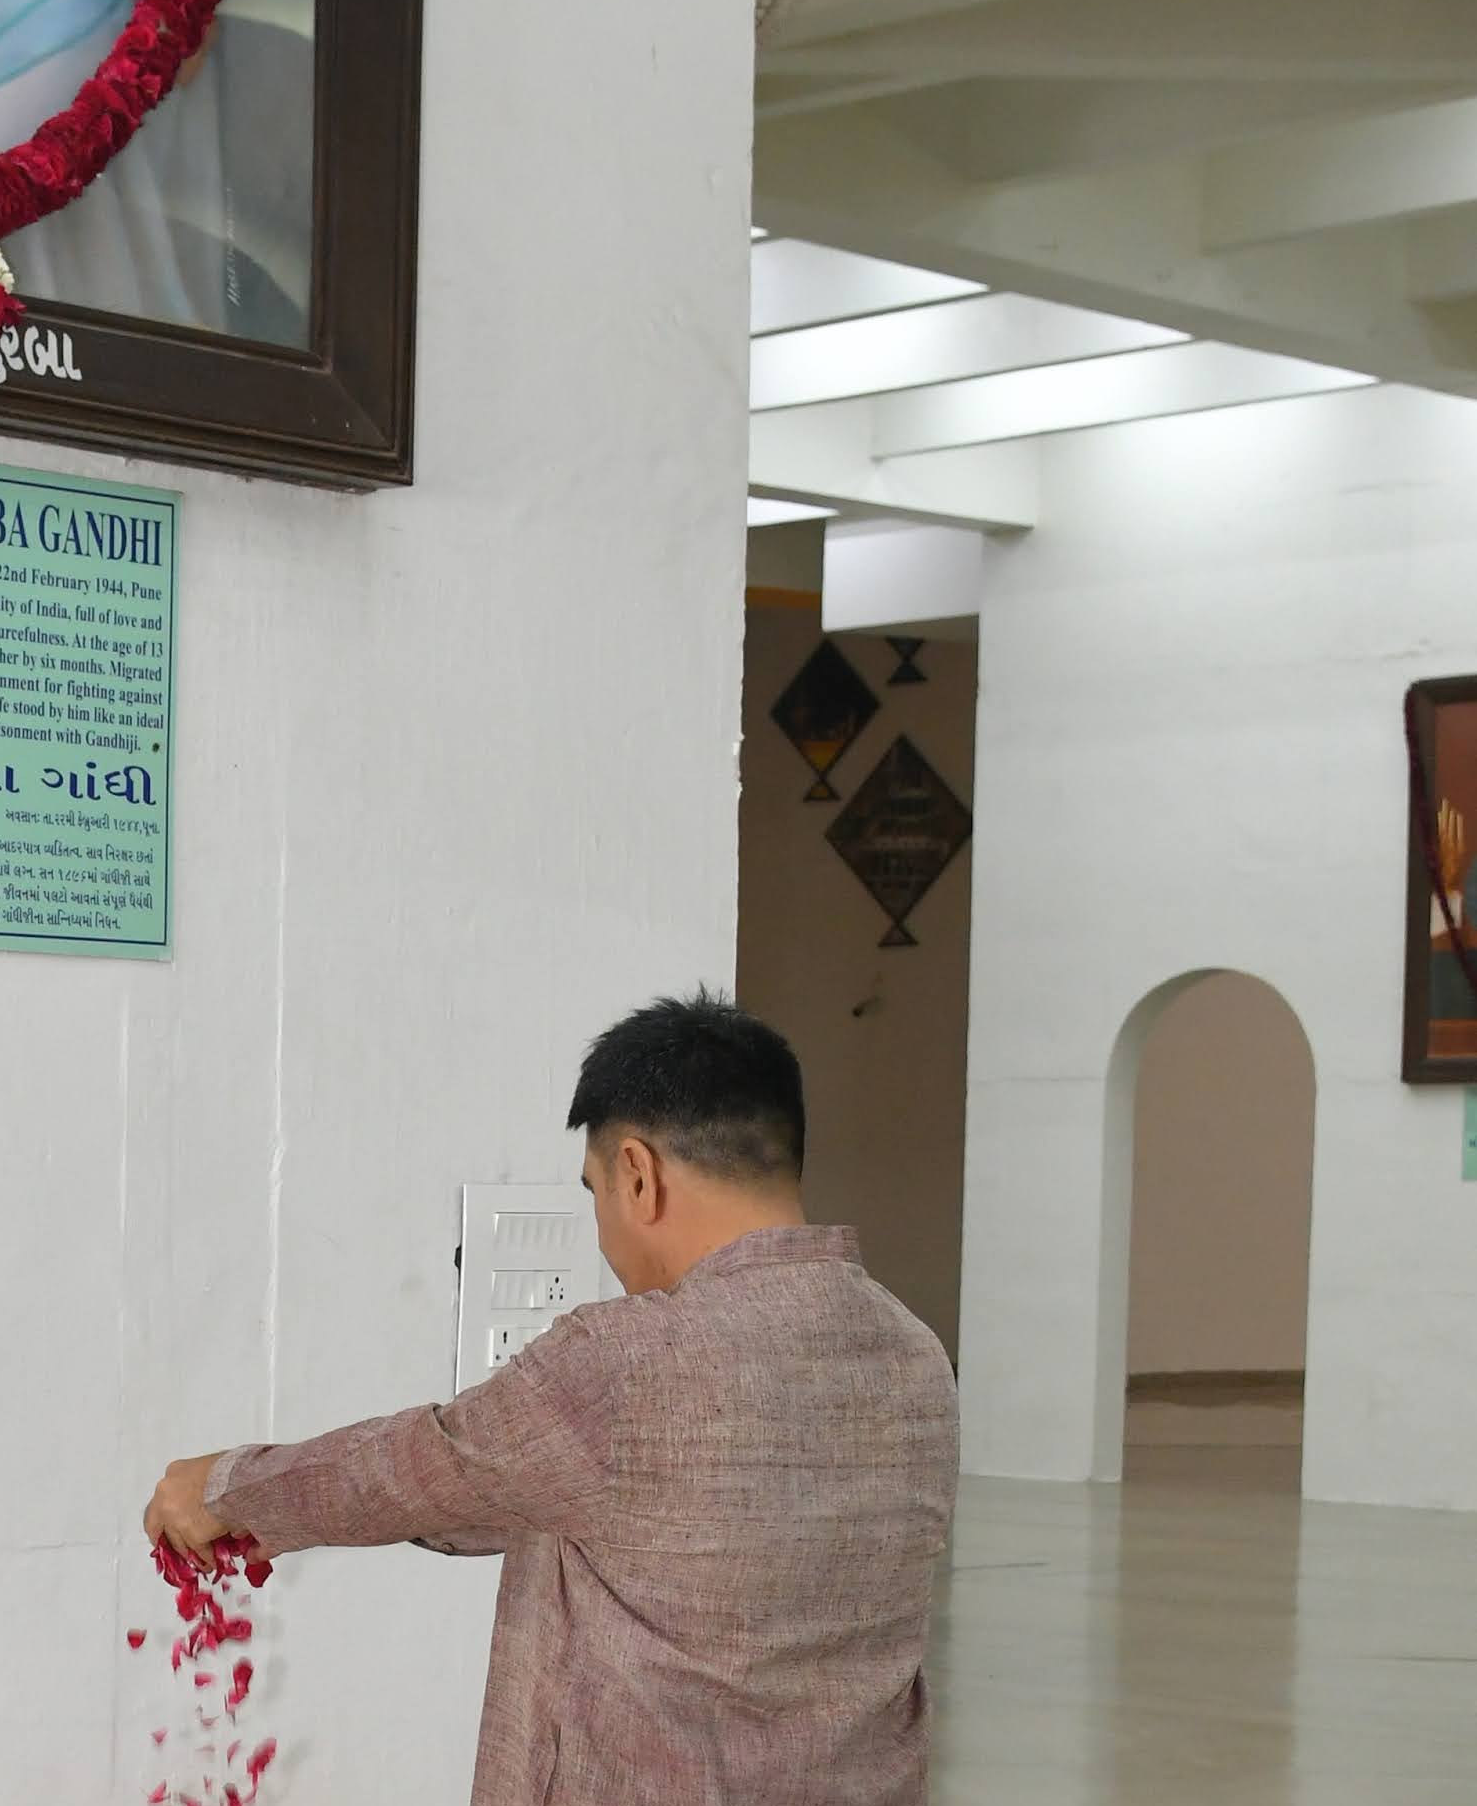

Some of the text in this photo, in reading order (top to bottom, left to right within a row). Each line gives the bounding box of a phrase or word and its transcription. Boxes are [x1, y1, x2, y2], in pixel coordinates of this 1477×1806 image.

[37, 503, 162, 567] GANDHI
[30, 567, 91, 596] February
[95, 576, 127, 599] 1944,
[130, 580, 162, 601] Pune
[19, 598, 34, 615] of
[35, 599, 71, 622] India,
[74, 604, 95, 623] full
[97, 607, 112, 624] of
[112, 608, 137, 628] love
[139, 614, 162, 631] and
[70, 631, 86, 649] At
[89, 634, 109, 652] the
[111, 640, 132, 658] age
[134, 639, 148, 656] of
[150, 640, 163, 658] 13
[21, 649, 37, 672] by
[39, 651, 56, 670] six
[59, 657, 106, 675] months.
[108, 659, 162, 683] Migrated
[43, 676, 63, 695] for
[66, 678, 115, 705] fighting
[117, 686, 163, 707] against
[12, 699, 45, 717] stood
[48, 700, 64, 723] by
[66, 702, 90, 722] him
[93, 705, 115, 725] like
[117, 712, 133, 727] an
[135, 710, 164, 730] ideal
[54, 726, 82, 745] with
[84, 729, 141, 755] Gandhiji.
[39, 760, 157, 806] ગાંધી
